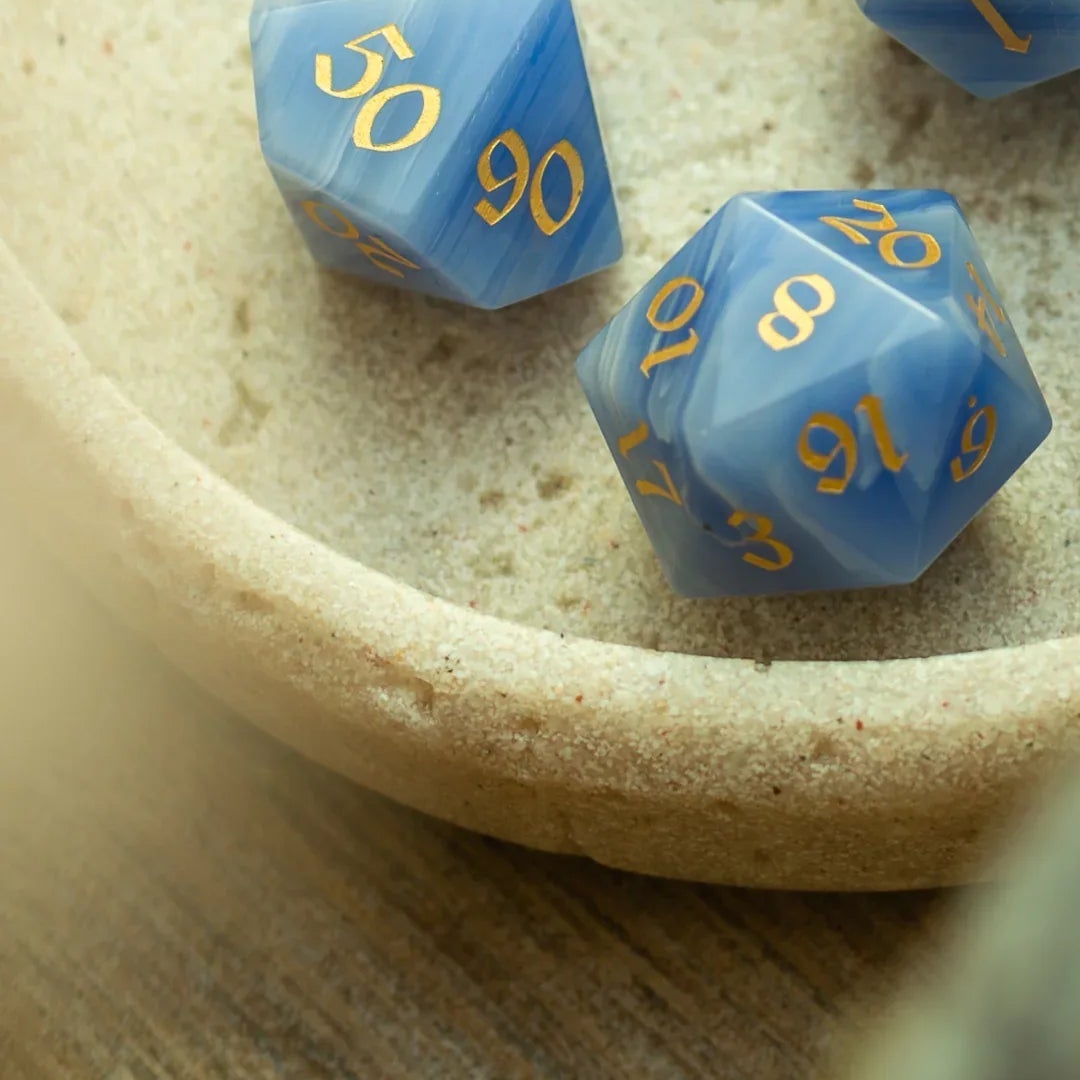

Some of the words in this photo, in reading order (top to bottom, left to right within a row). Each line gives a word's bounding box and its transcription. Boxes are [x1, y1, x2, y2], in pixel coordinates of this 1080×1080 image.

[315, 23, 442, 152] 50
[473, 128, 585, 237] 90
[819, 198, 942, 269] 20
[640, 275, 705, 379] 10
[757, 273, 836, 351] 8
[797, 394, 910, 496] 16
[727, 509, 793, 571] 3
